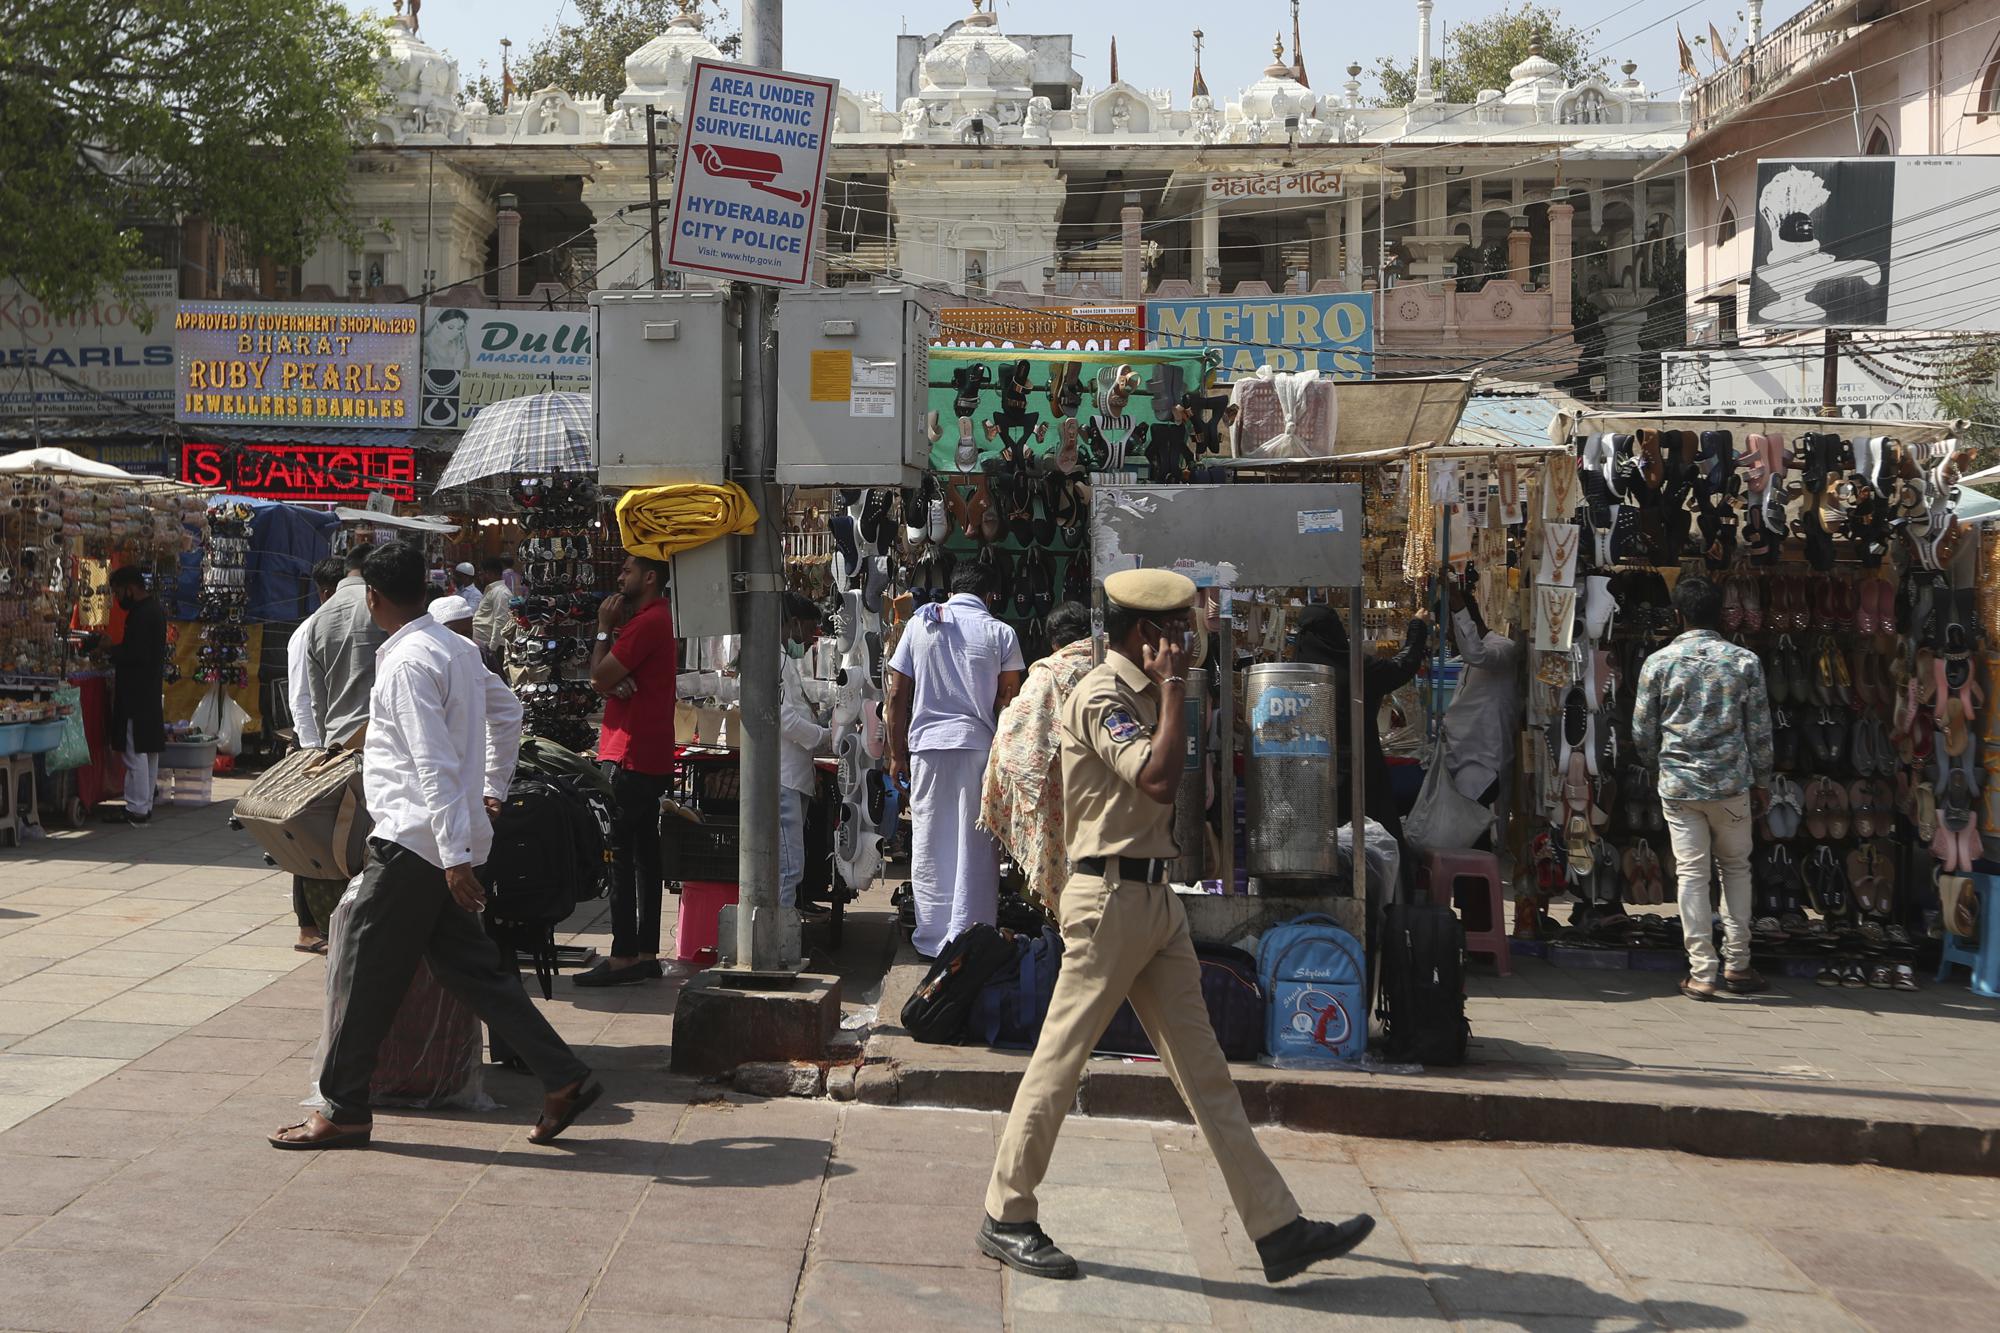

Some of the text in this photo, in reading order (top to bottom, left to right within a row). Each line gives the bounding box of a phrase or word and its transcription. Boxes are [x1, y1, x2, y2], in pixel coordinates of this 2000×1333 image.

[710, 76, 815, 107] AREA UNDER
[708, 96, 812, 126] ELECTRONIC
[695, 116, 818, 149] SURVEILLANCE
[687, 196, 804, 229] HYDERABAD
[681, 220, 801, 253] CITY POLICE
[698, 246, 782, 267] Visit: www.htp.gov.in
[175, 313, 237, 330] APPROVED
[240, 315, 254, 331] BY
[258, 315, 337, 333] GOVERNMENT
[340, 317, 371, 333] SHOP
[1157, 302, 1366, 348] METRO
[238, 333, 351, 356] BHARAT
[476, 353, 550, 364] MASALA
[189, 356, 401, 393] RUBY PEARLS
[41, 393, 60, 402] ALL
[185, 394, 405, 417] JEWELLERS & BANGLES
[1743, 398, 1788, 406] JEWELLERS
[1836, 394, 1890, 403] ASSOCIATION
